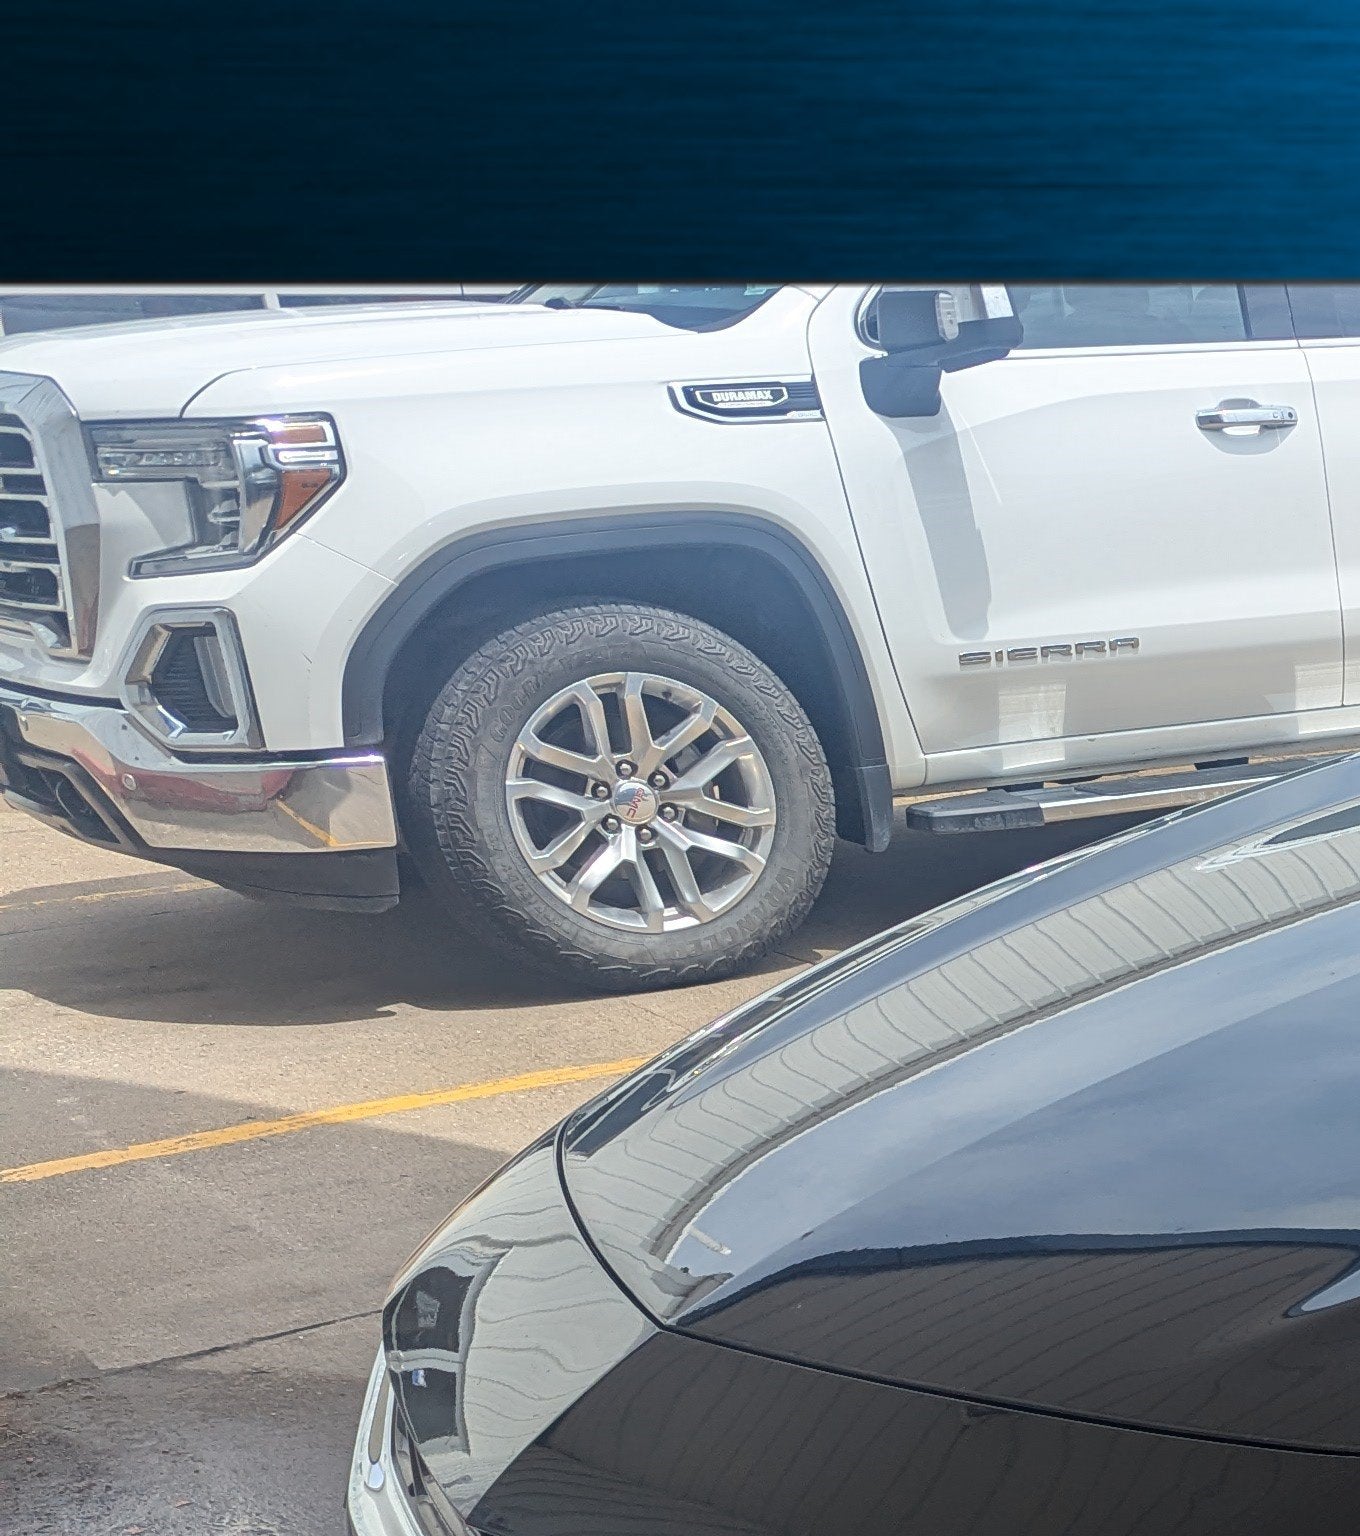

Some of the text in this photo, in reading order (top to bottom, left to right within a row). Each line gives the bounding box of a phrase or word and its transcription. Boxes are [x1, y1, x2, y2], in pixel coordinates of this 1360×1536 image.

[712, 390, 774, 402] DURAMAX
[958, 637, 1140, 665] SIERRA
[626, 787, 645, 819] GMC
